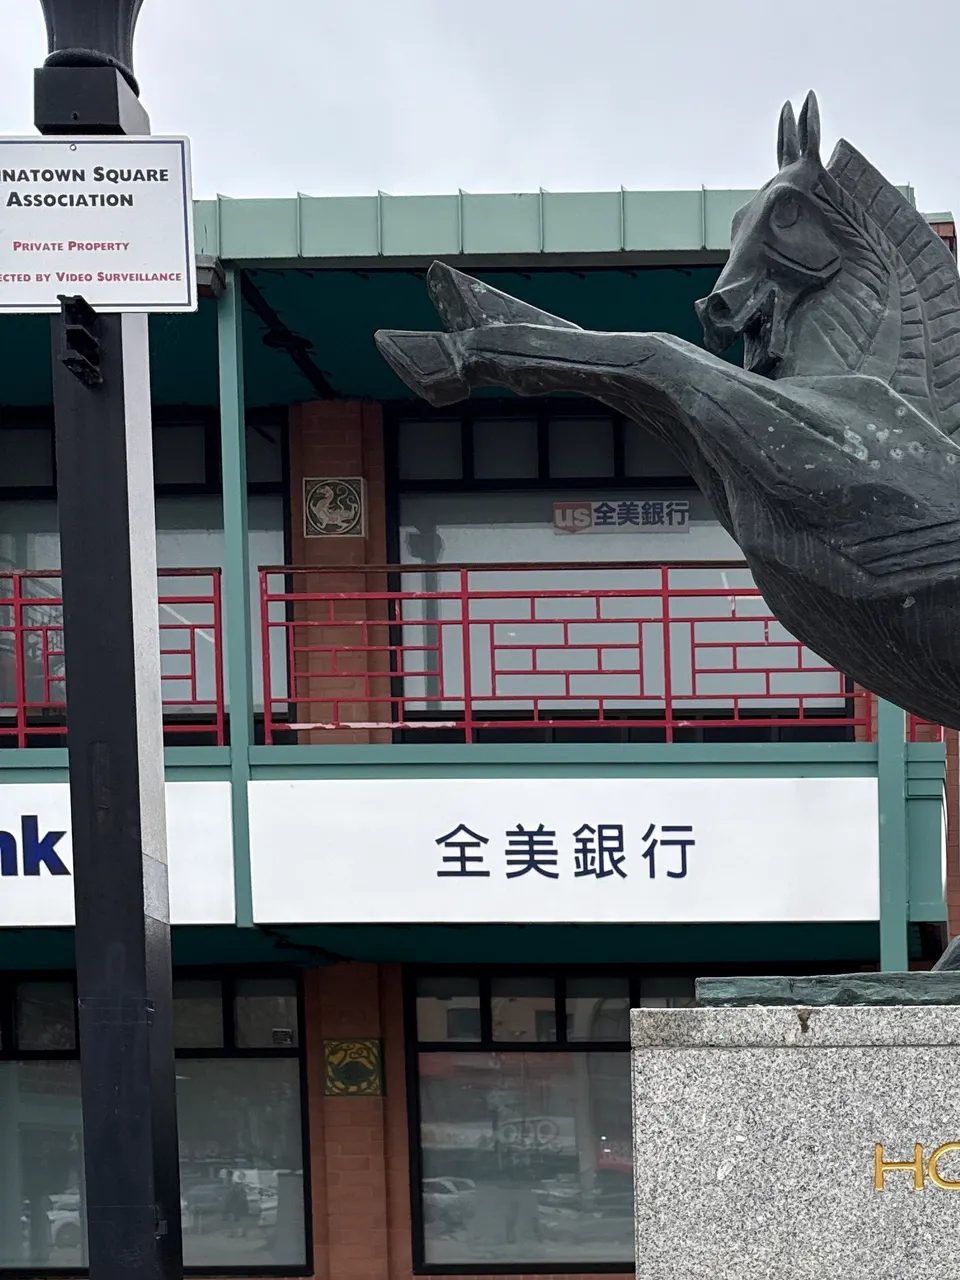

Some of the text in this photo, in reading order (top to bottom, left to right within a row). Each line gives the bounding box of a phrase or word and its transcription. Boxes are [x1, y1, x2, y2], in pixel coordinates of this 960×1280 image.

[93, 166, 169, 184] SQUARE
[6, 191, 134, 207] ASSOCIATION
[13, 241, 130, 251] PRIVATE PROPERTY
[35, 273, 51, 282] BY
[55, 272, 93, 282] VIDEO
[97, 272, 182, 282] SURVEILLANCE
[593, 502, 689, 526] 全美銀行
[435, 823, 696, 879] 全美銀行
